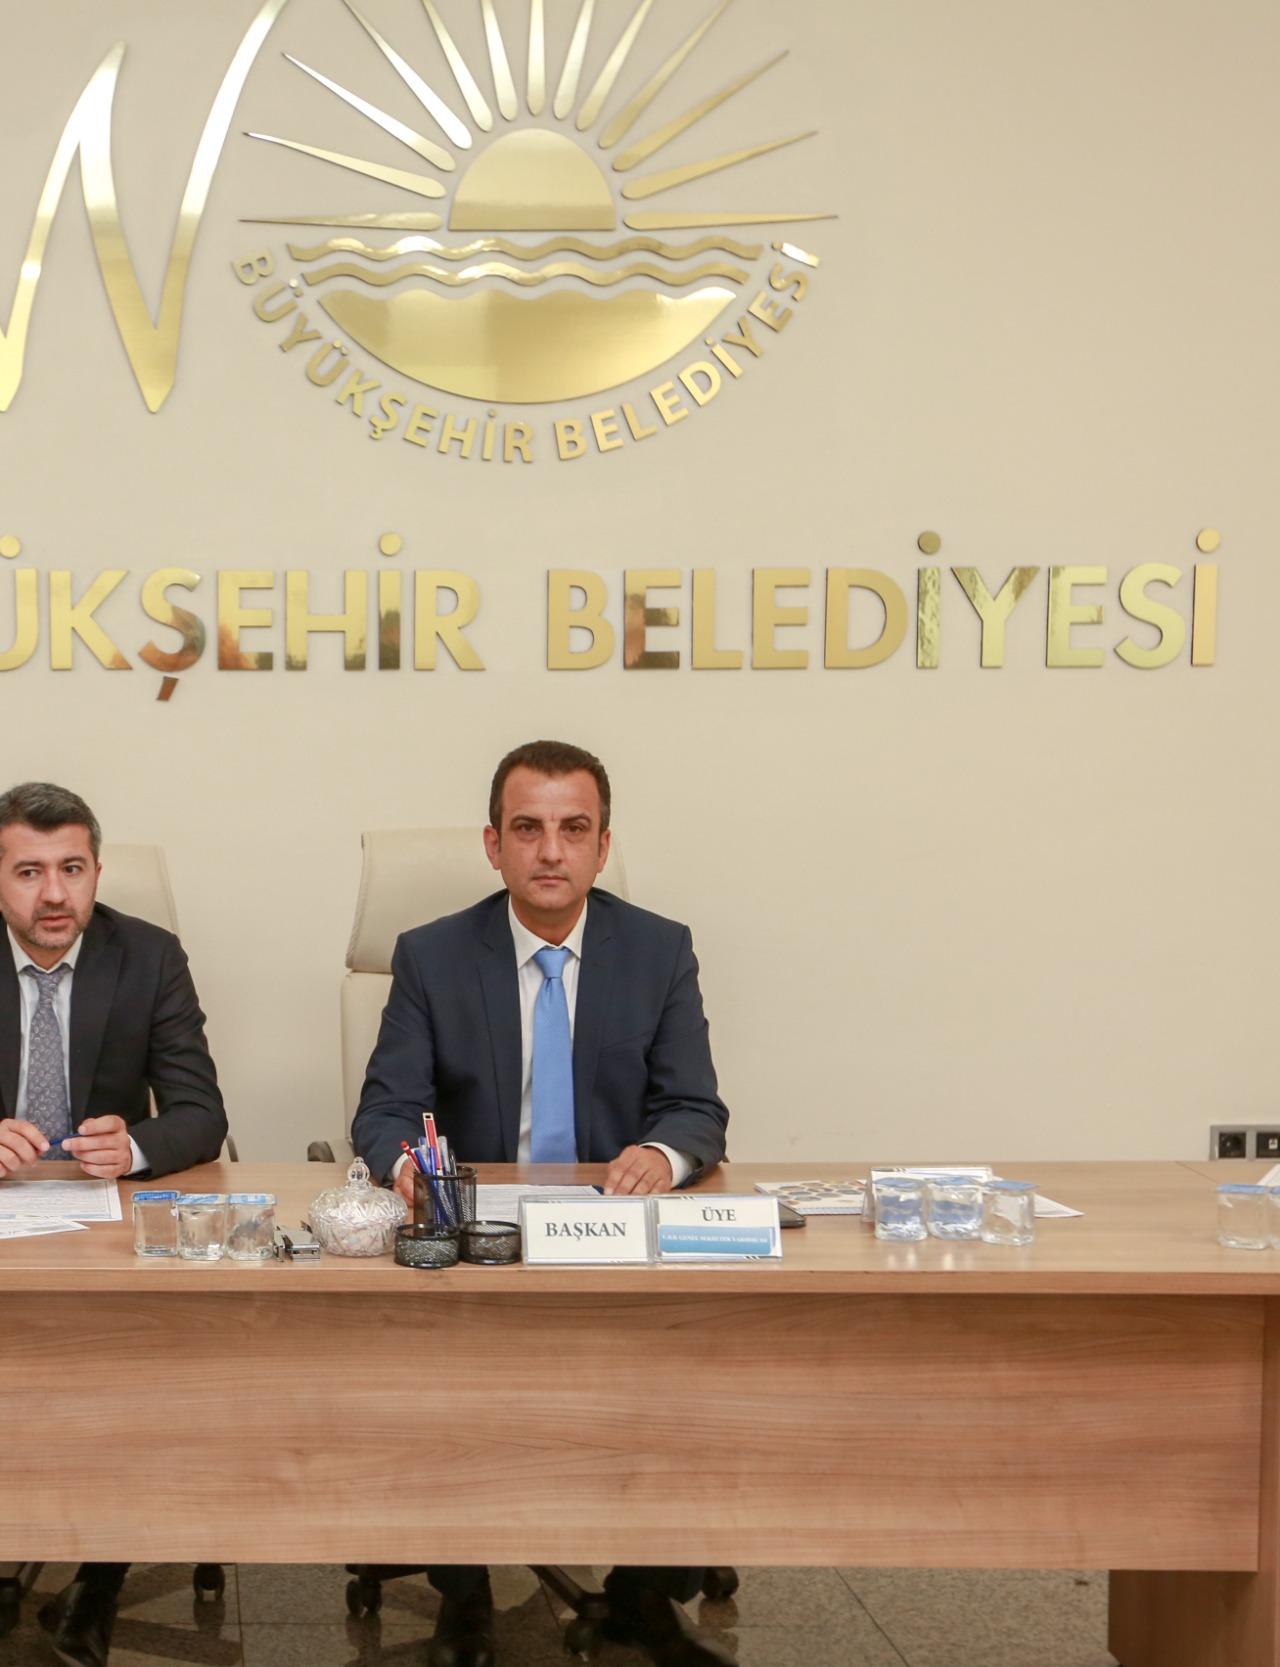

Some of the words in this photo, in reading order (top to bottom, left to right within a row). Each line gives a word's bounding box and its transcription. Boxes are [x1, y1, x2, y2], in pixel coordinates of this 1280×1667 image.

[231, 247, 533, 463] BÜYÜKŞEHİR
[553, 241, 820, 461] BELEDİYESİ
[546, 528, 1220, 670] BELEDİYESİ
[545, 1222, 627, 1242] BAŞKAN
[701, 1206, 737, 1221] ÜYE
